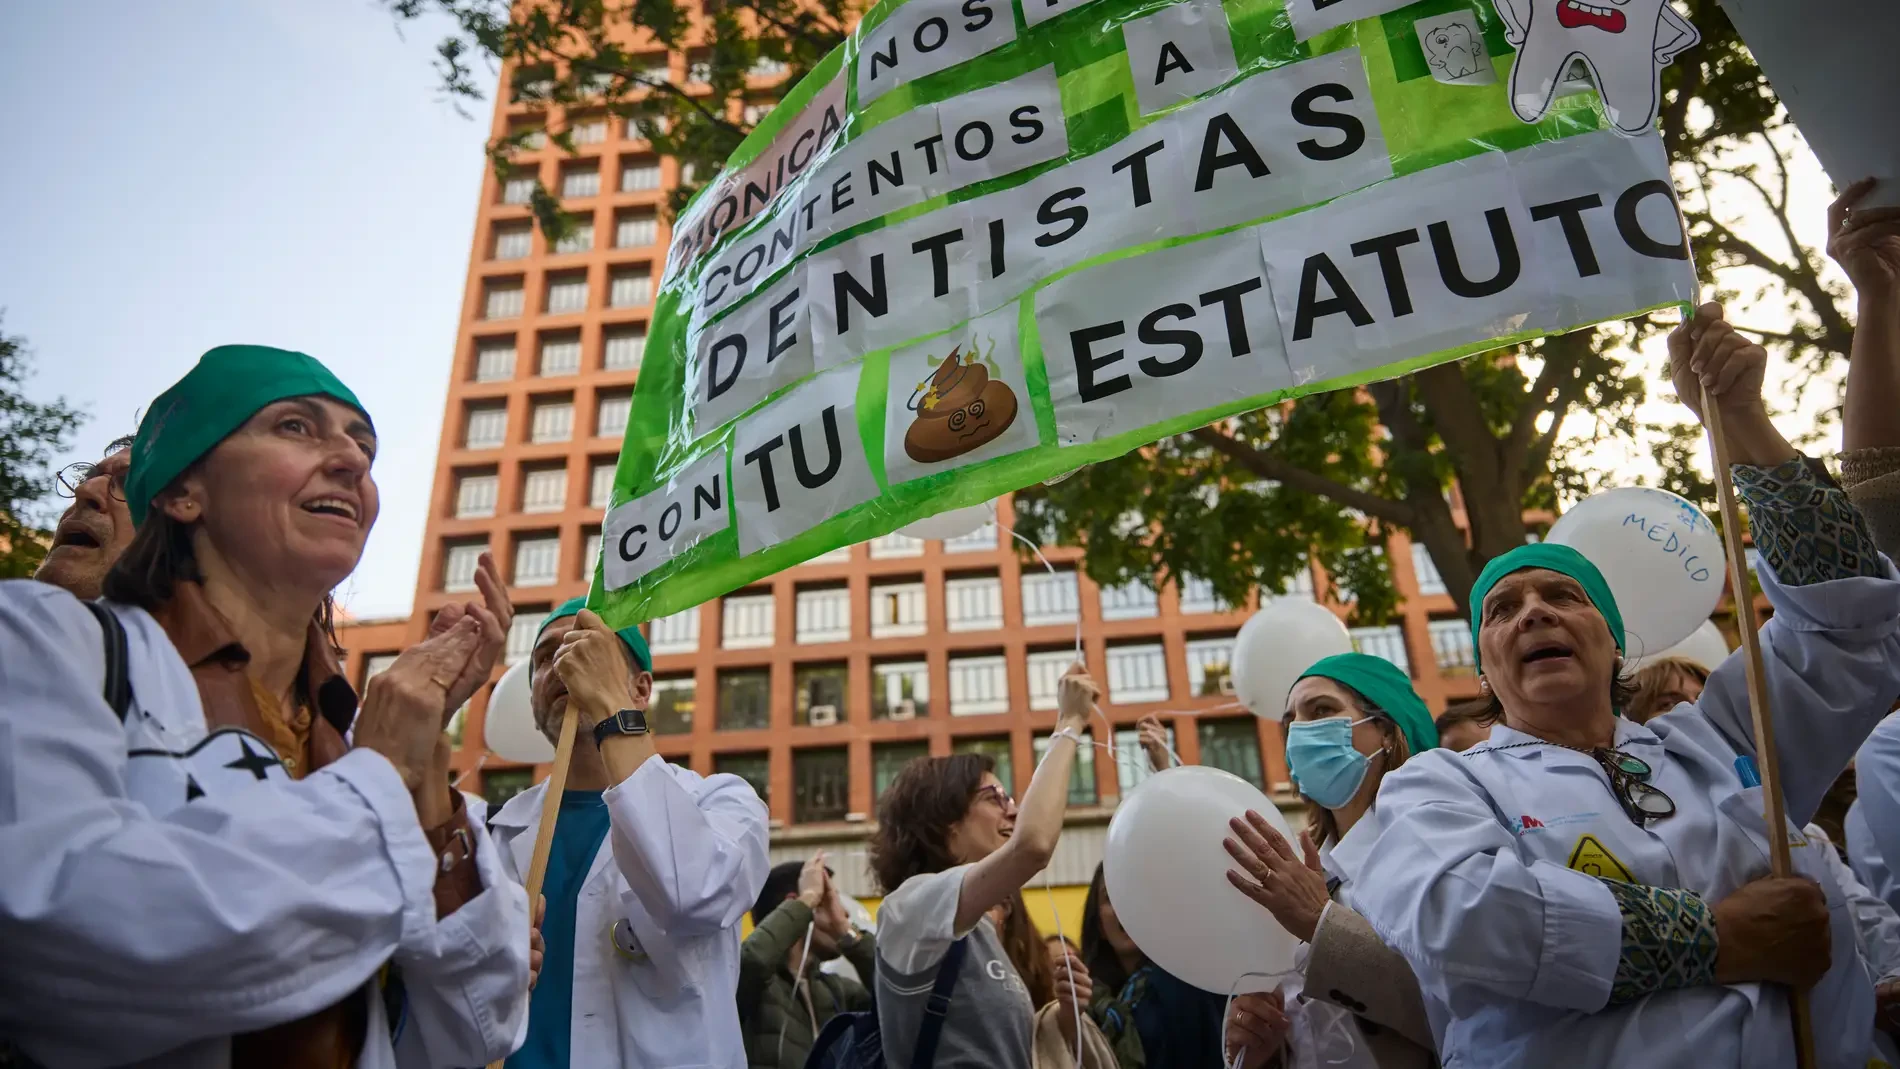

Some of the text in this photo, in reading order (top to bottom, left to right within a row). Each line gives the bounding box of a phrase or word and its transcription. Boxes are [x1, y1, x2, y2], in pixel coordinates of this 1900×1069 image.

[702, 41, 1195, 308] CONTENTOS A
[870, 0, 994, 81] NOS
[618, 178, 1689, 563] CON TU ESTATUTO
[707, 82, 1366, 401] DENTISTAS
